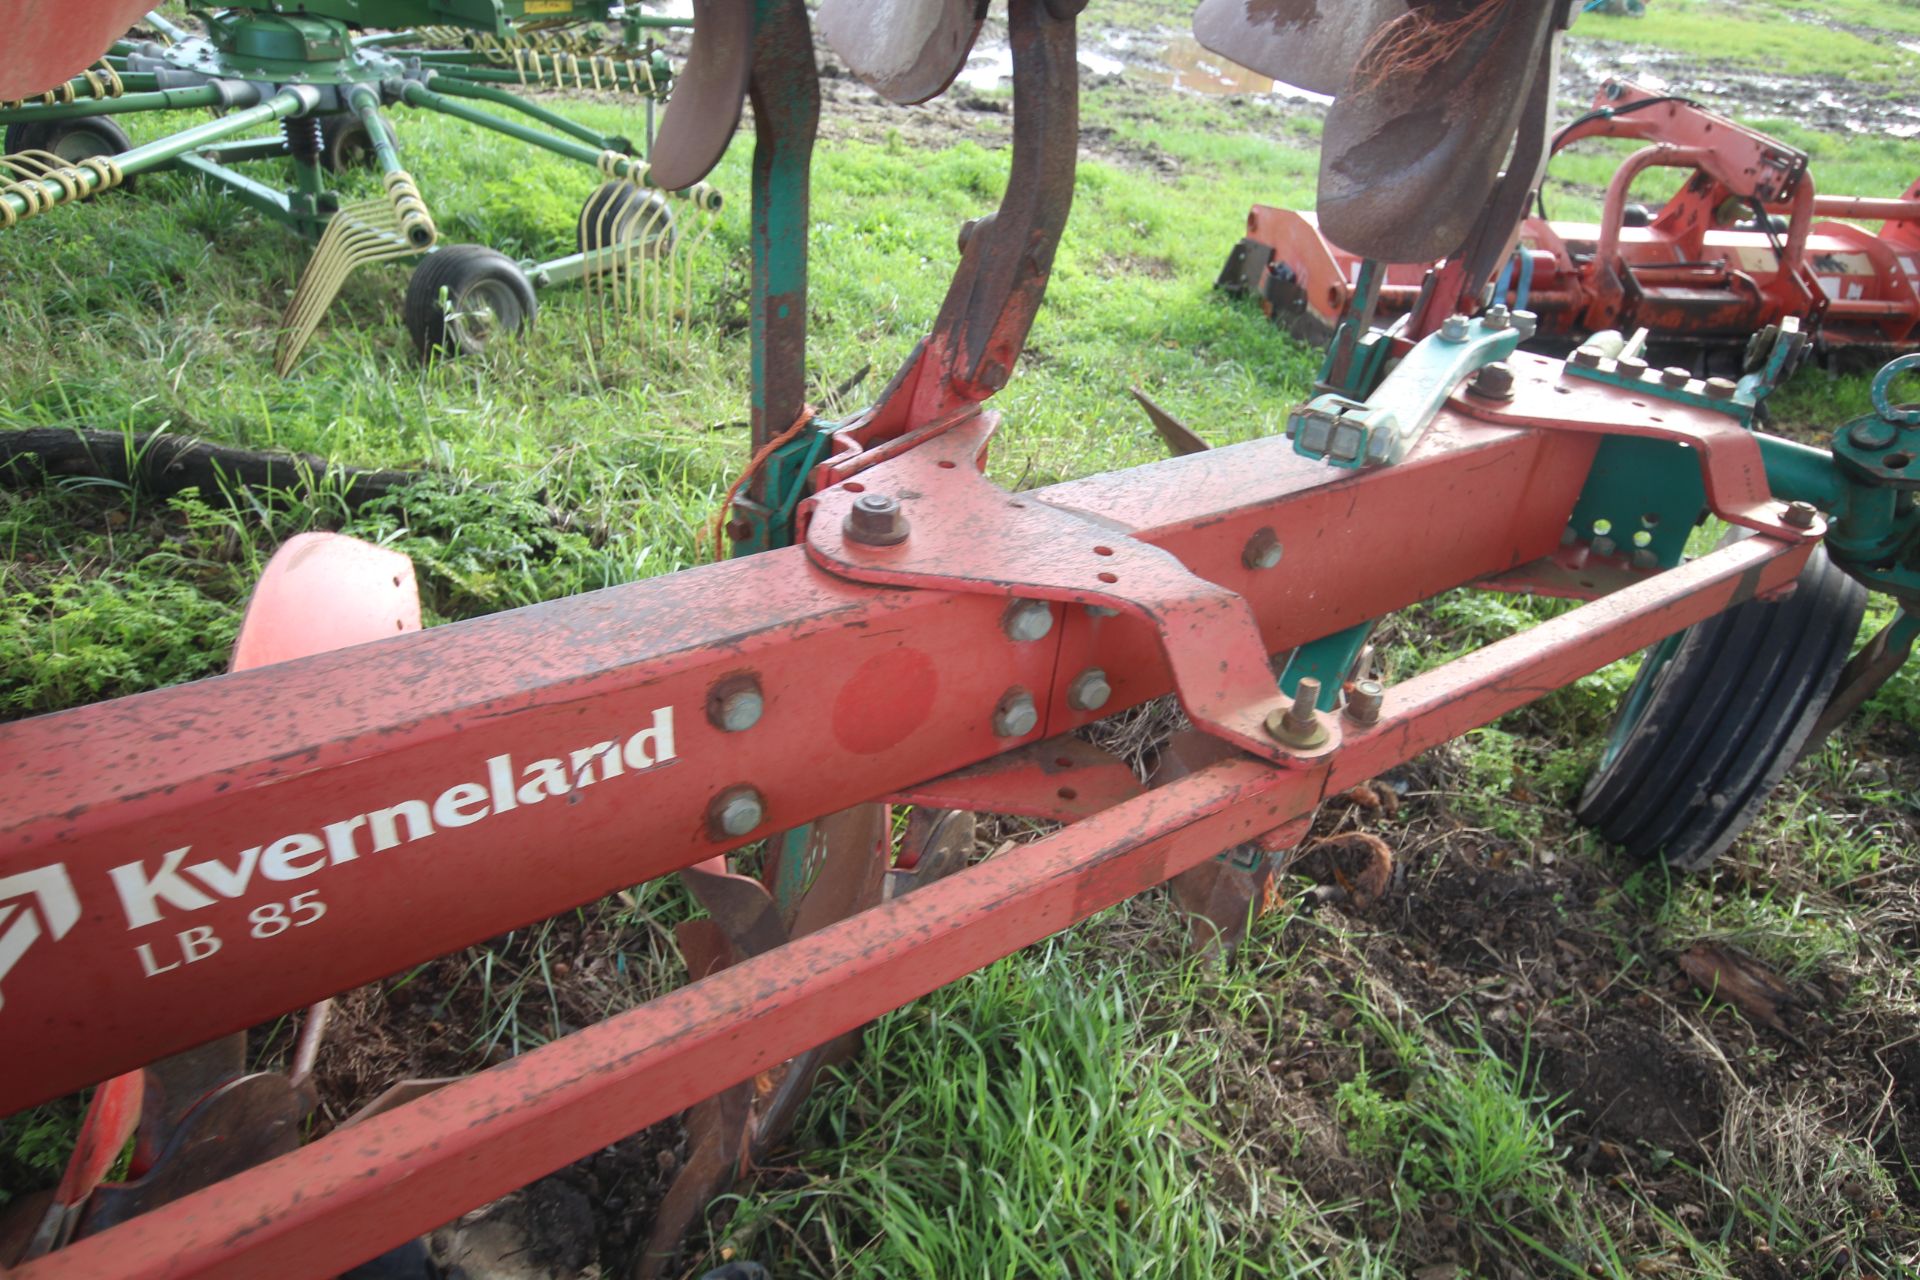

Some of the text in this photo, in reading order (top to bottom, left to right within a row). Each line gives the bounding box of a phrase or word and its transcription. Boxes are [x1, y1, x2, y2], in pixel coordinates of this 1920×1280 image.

[109, 706, 677, 930] Kverneland
[135, 888, 327, 978] LB 85
